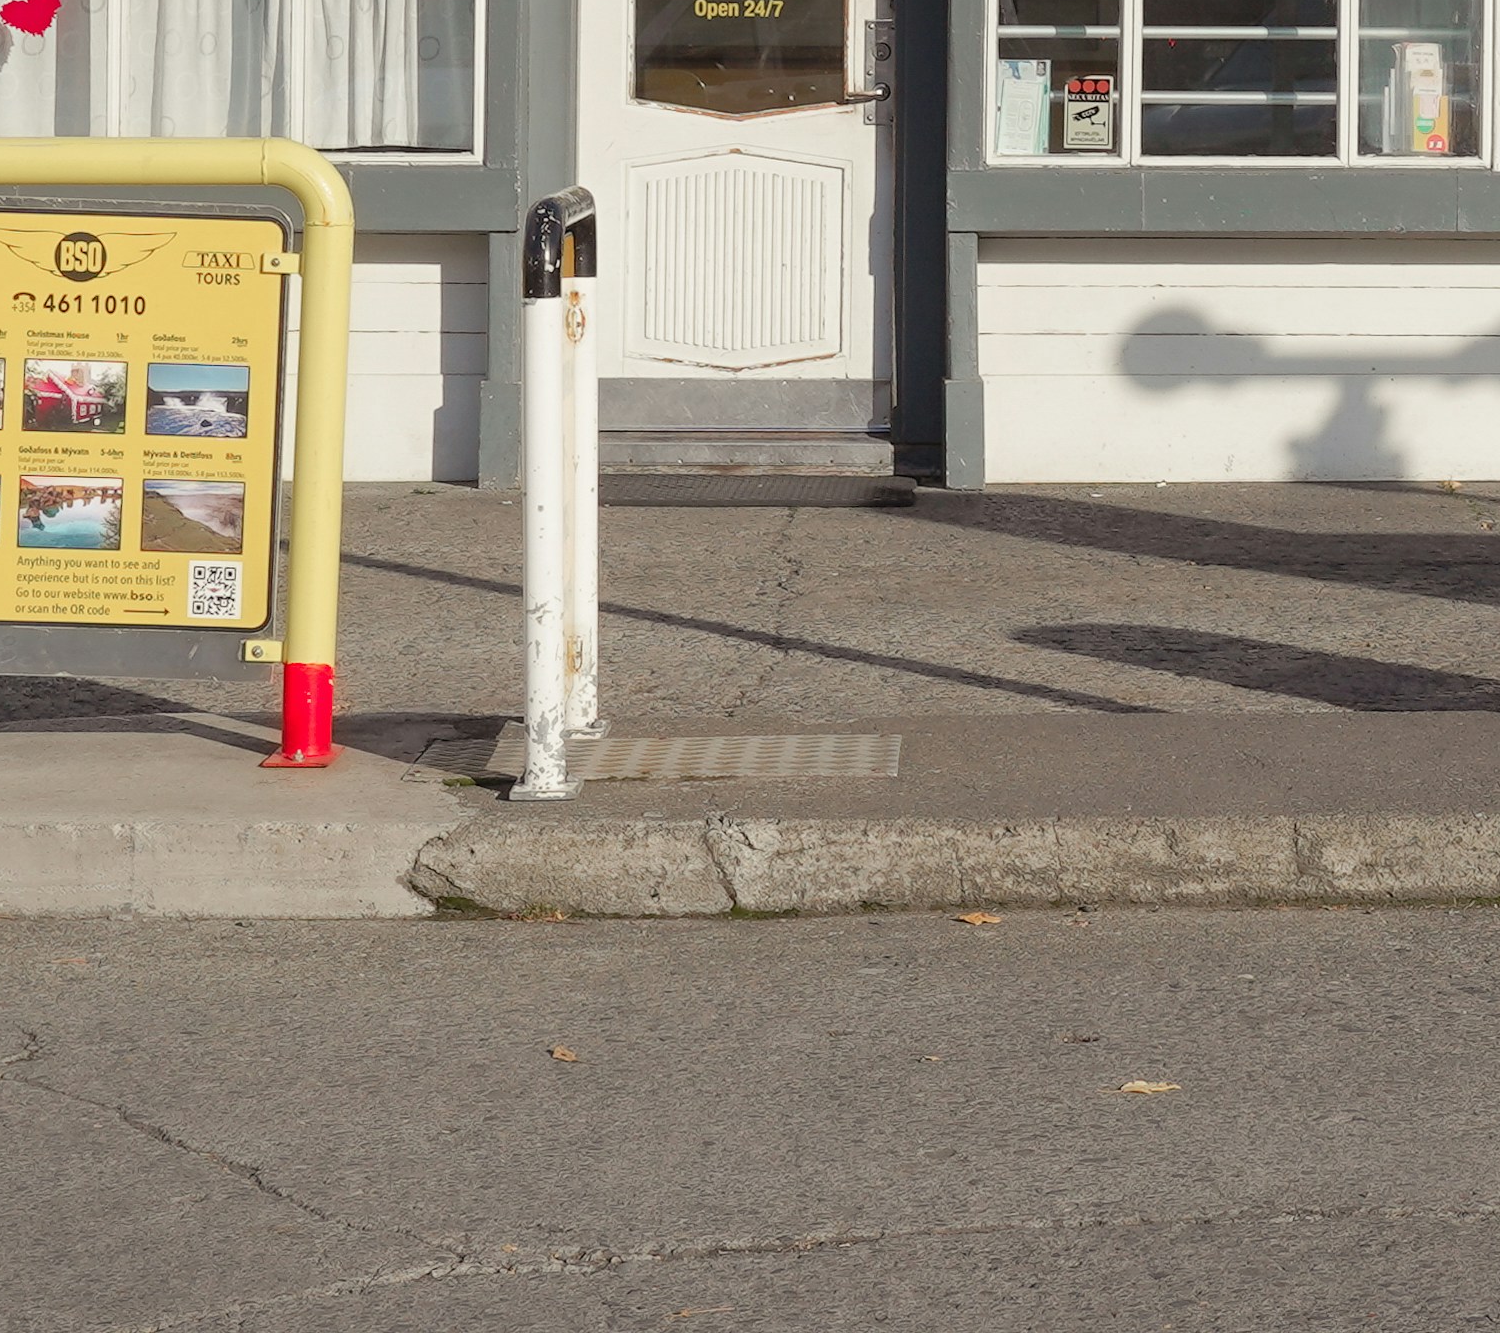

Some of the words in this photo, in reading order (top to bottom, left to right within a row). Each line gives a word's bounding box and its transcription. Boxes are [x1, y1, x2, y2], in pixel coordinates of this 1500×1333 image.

[744, 0, 784, 18] 24/7
[60, 240, 102, 273] BSO
[197, 252, 241, 268] TAXI
[196, 272, 240, 285] TOURS
[12, 303, 36, 313] +354
[43, 293, 83, 315] 461
[91, 294, 146, 315] 1010
[67, 331, 89, 339] House
[17, 556, 61, 570] Anything
[64, 559, 82, 569] you
[85, 559, 108, 568] want
[111, 560, 120, 568] to
[142, 560, 160, 570] and
[17, 573, 70, 583] experience
[73, 573, 88, 583] but
[91, 574, 99, 583] is
[102, 575, 117, 584] not
[121, 576, 133, 584] on
[136, 575, 153, 585] this
[155, 575, 175, 586] list?
[16, 587, 29, 598] Go
[32, 589, 41, 598] to
[44, 590, 60, 598] our
[63, 589, 100, 599] website
[103, 590, 164, 601] www.bso.is
[15, 605, 25, 613] or
[52, 604, 67, 614] the
[70, 605, 85, 615] QR
[87, 605, 110, 615] code
